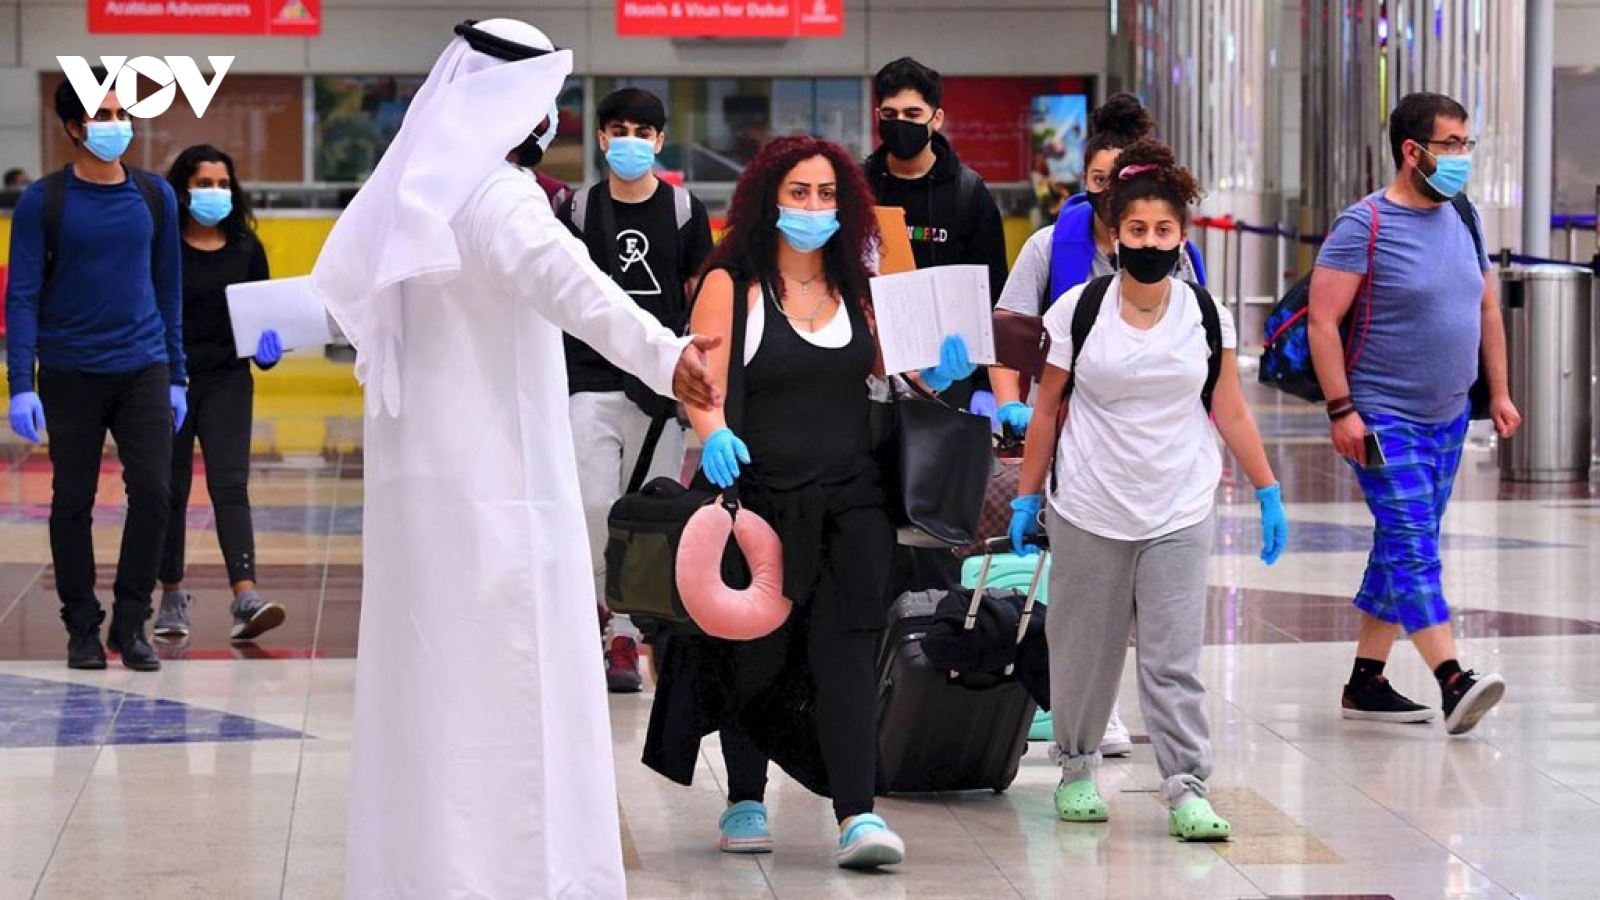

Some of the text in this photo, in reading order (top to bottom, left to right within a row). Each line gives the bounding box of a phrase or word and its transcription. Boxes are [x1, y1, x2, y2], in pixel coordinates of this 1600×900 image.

[166, 1, 251, 16] Adventures
[723, 2, 744, 17] for
[746, 2, 790, 17] Dubai
